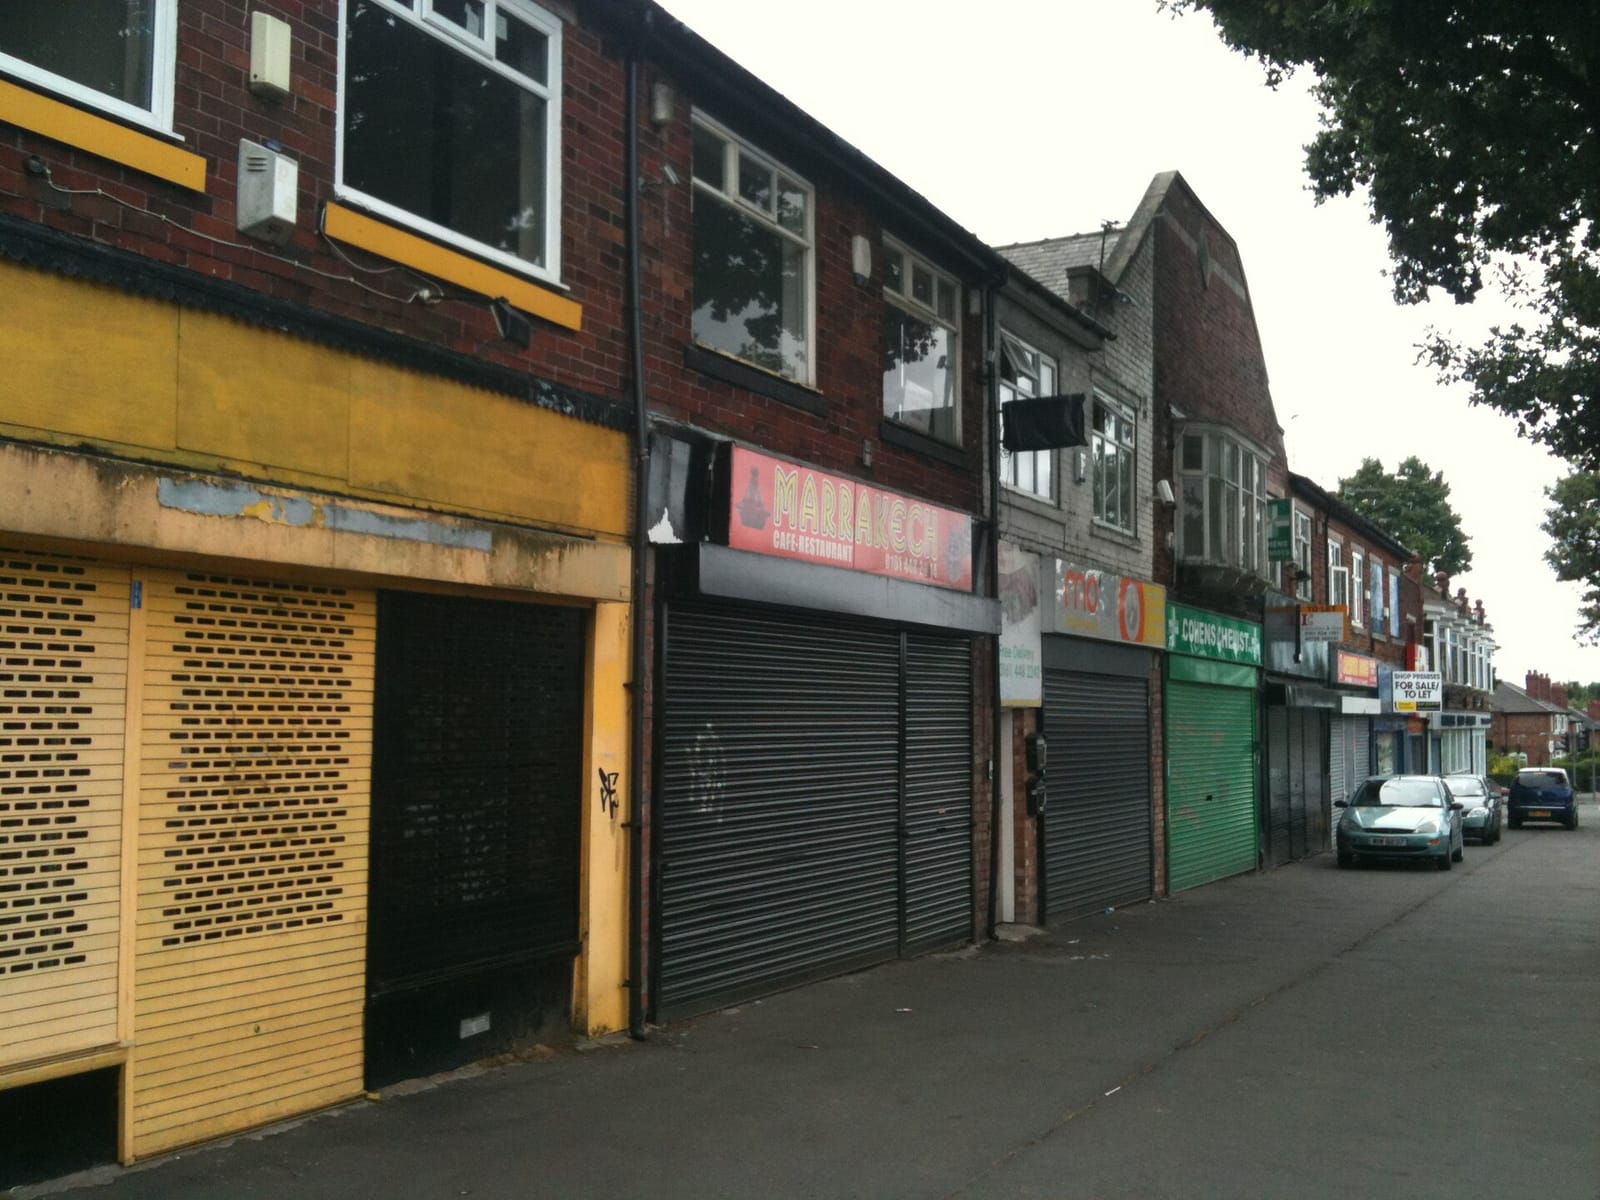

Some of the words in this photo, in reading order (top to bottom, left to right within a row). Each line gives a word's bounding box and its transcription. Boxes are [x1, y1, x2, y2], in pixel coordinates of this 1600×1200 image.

[773, 465, 938, 560] MARRAKECH
[1182, 618, 1217, 647] COHENS
[1217, 626, 1250, 653] CHEMIST
[1395, 681, 1413, 690] FOR
[1415, 681, 1439, 691] SALE/
[1404, 690, 1416, 699] TO
[1418, 690, 1432, 699] LET
